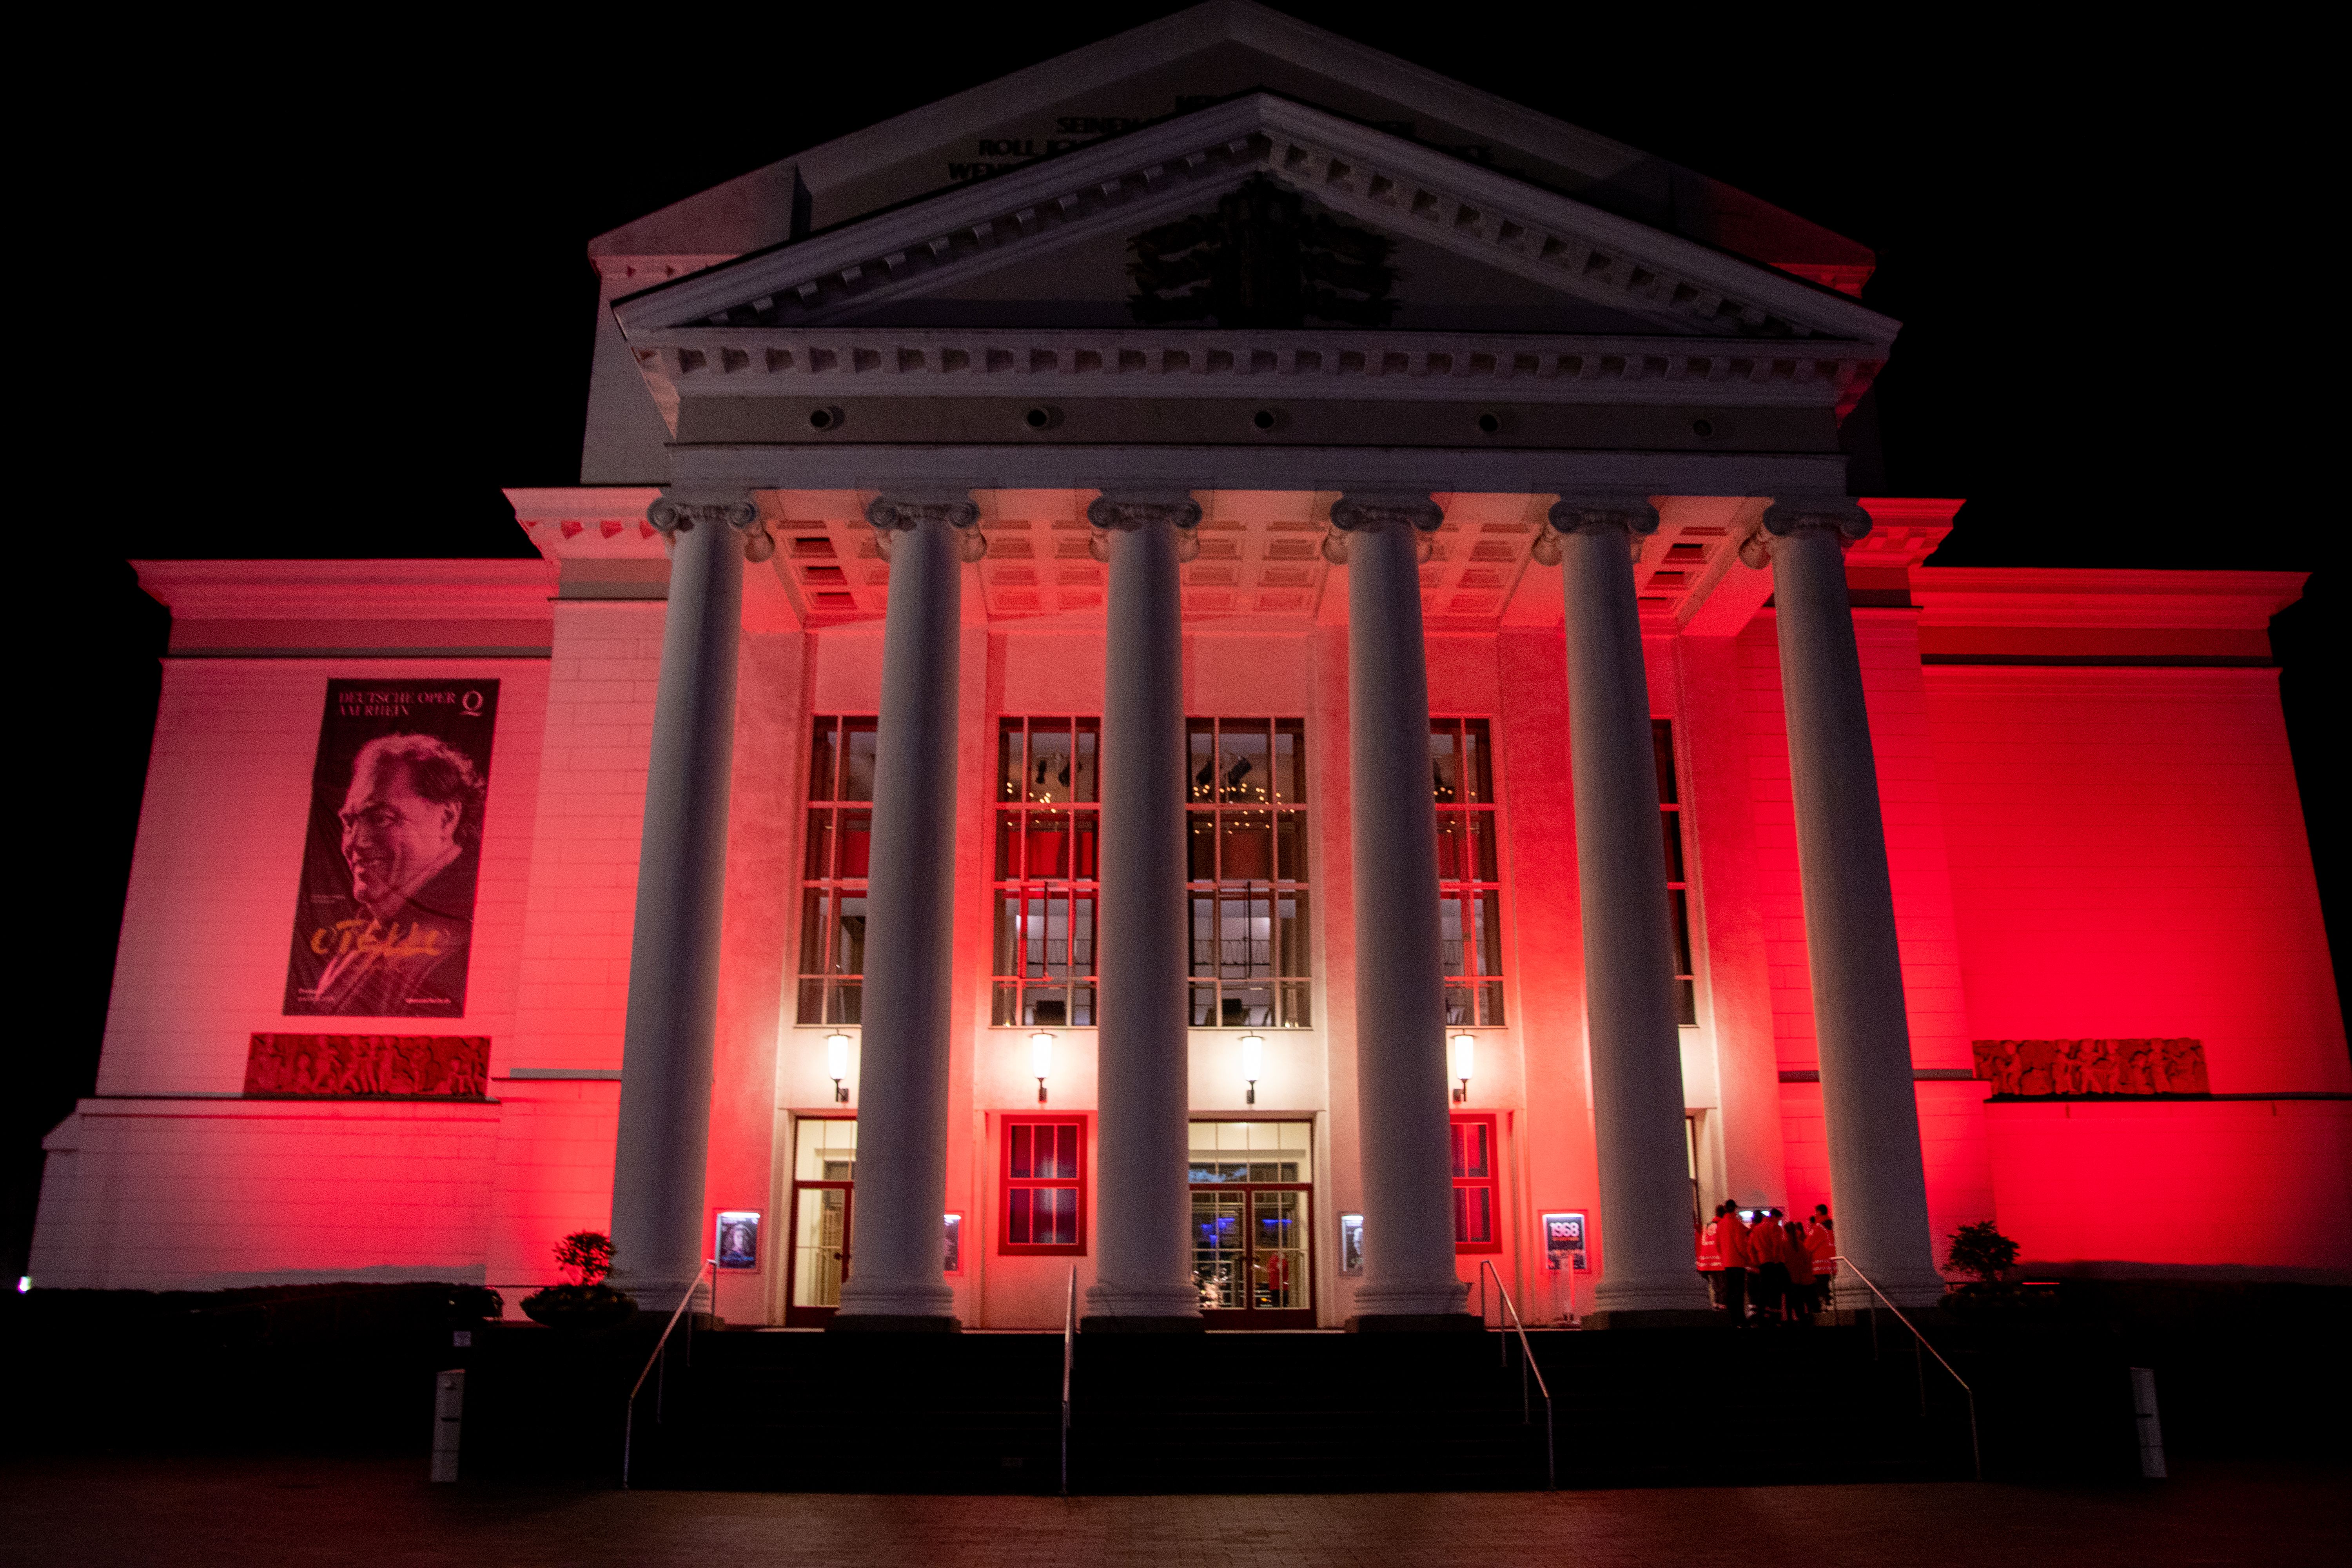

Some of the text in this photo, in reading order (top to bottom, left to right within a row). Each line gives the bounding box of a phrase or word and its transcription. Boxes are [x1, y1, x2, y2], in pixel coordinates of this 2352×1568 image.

[979, 139, 1035, 156] ROLL
[338, 691, 456, 704] DEUTSCHE OPER
[364, 704, 410, 717] RHEIN
[1549, 1222, 1580, 1237] 1968
